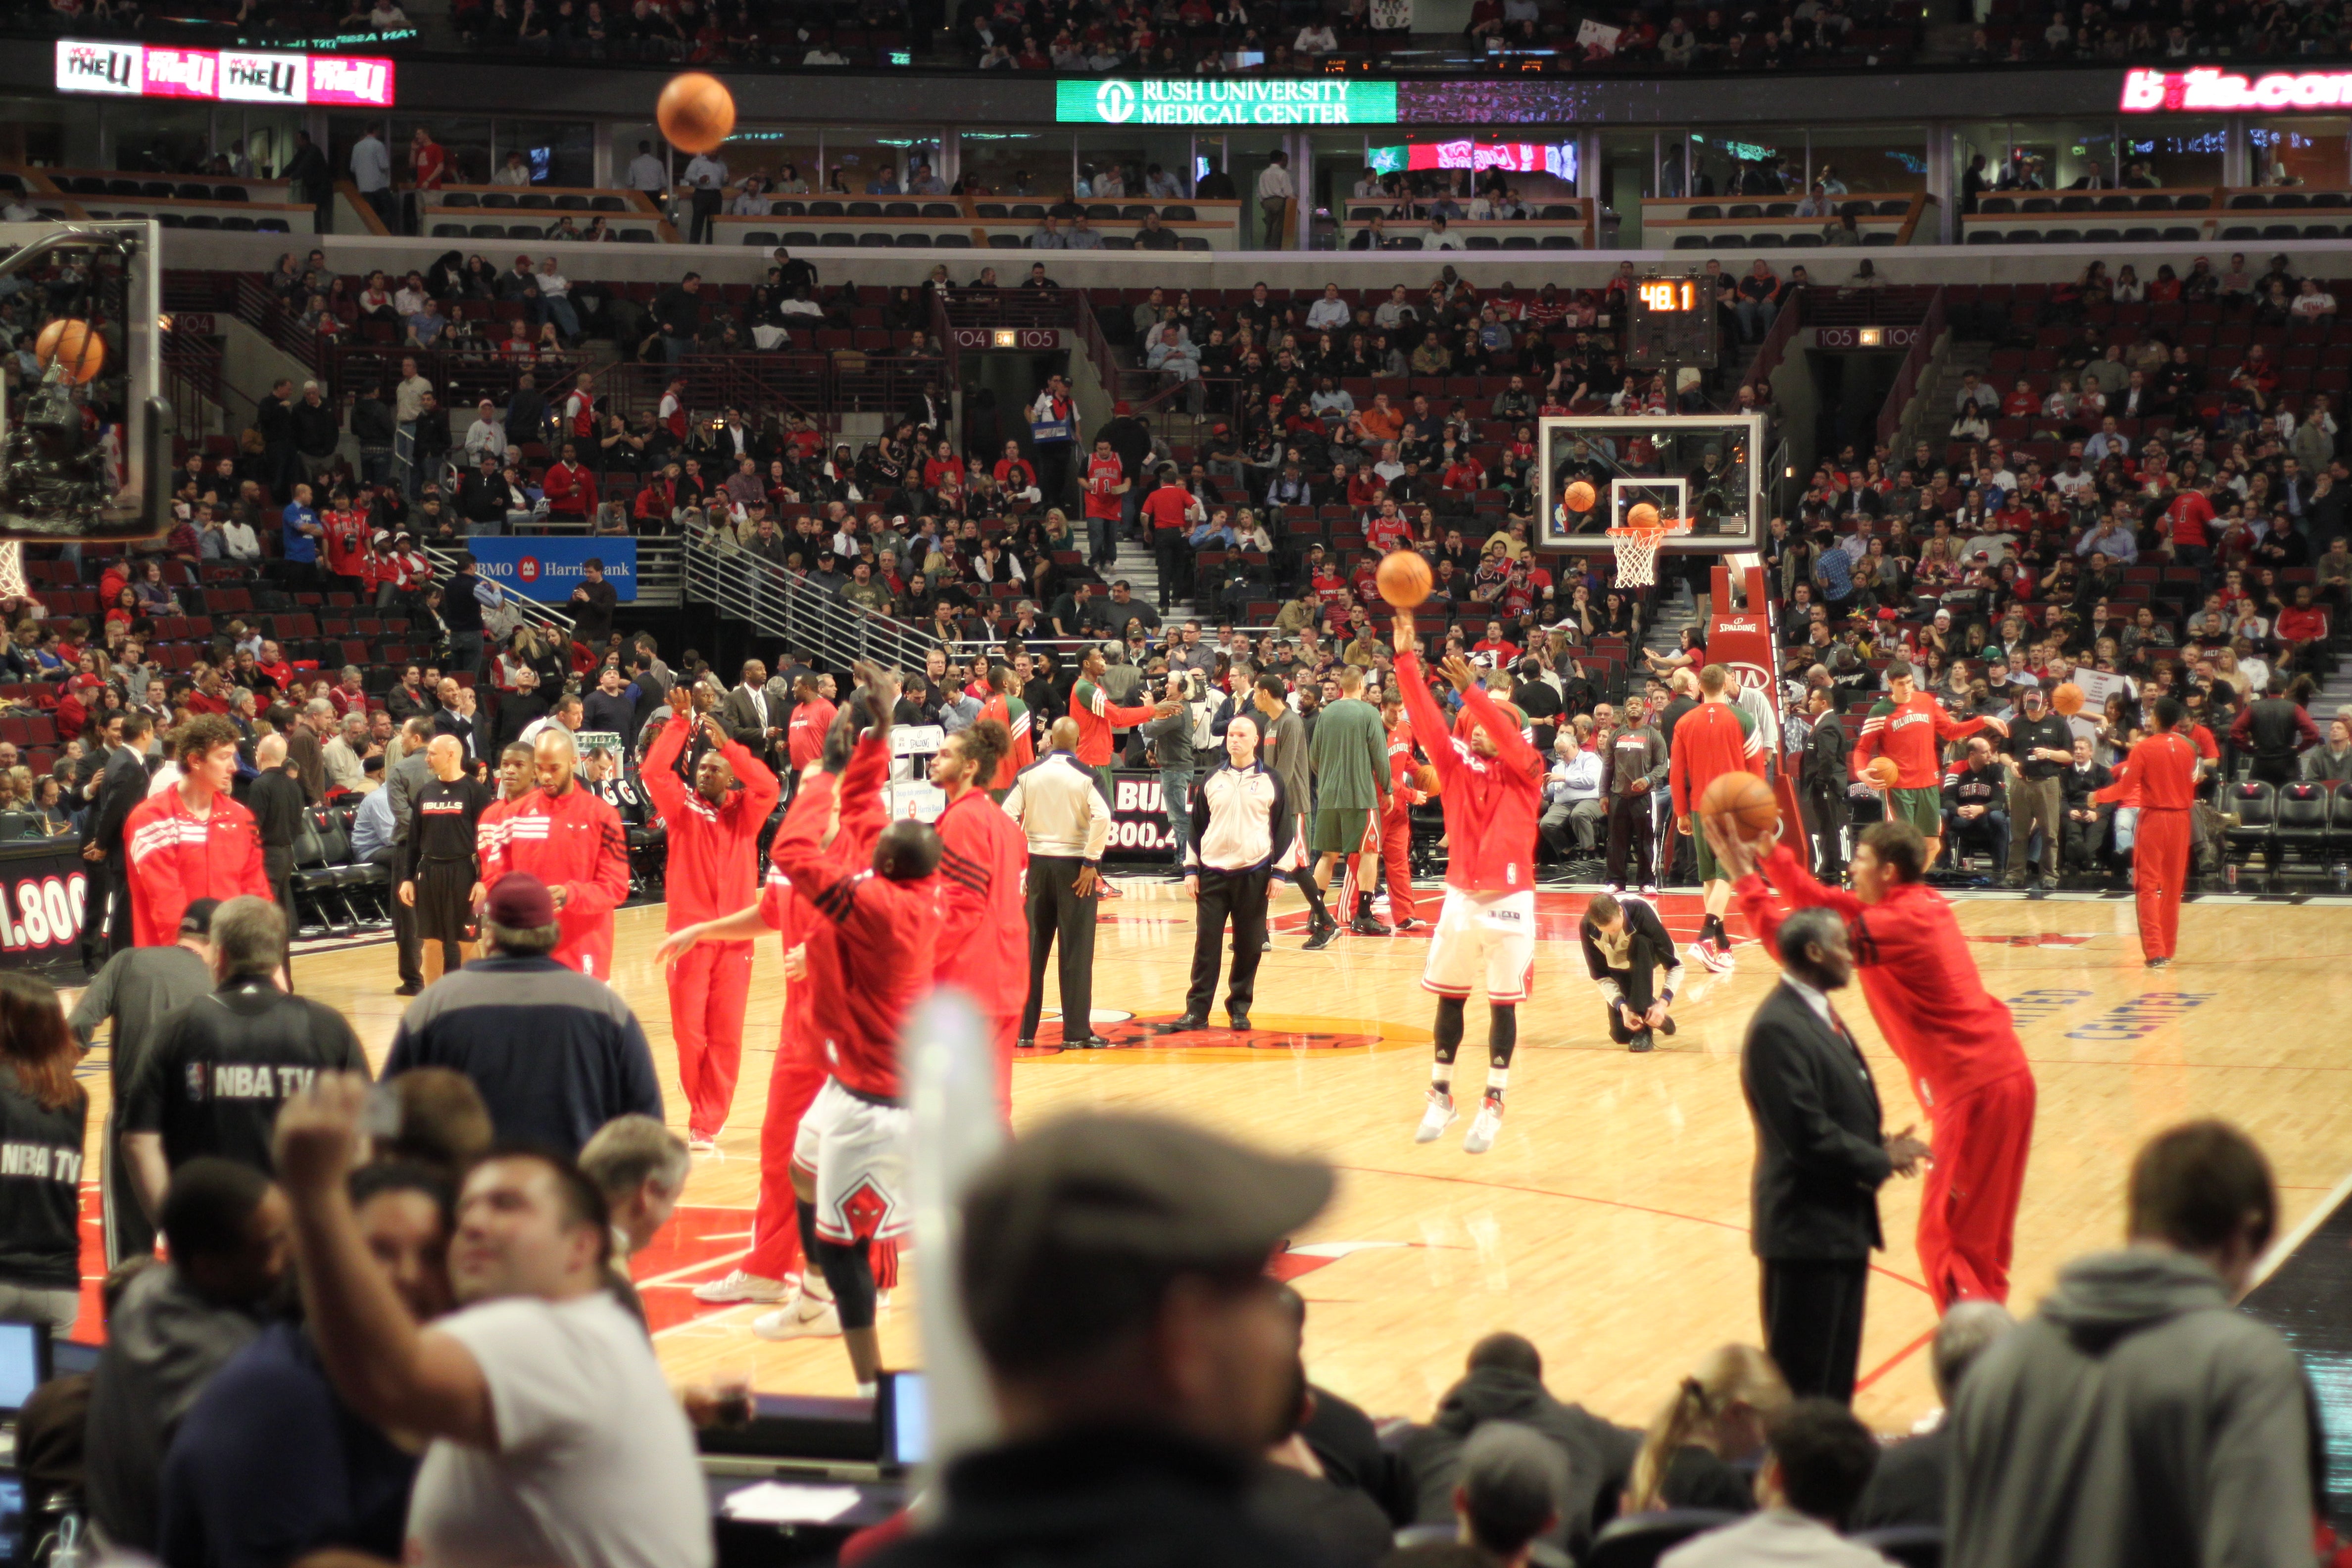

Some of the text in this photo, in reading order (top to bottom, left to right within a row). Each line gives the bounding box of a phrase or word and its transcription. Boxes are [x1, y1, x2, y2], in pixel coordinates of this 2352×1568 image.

[106, 50, 132, 88] U
[268, 60, 296, 97] U
[1142, 81, 1350, 102] RUSH UNIVERSITY
[1142, 103, 1350, 124] MEDICAL CENTER
[1640, 285, 1689, 310] 48.1
[954, 331, 985, 346] 104
[996, 333, 1013, 345] EXIT
[1023, 331, 1052, 346] 105
[1821, 330, 1852, 345] 105
[1862, 331, 1879, 344] EXIT
[1889, 329, 1919, 345] 106
[477, 563, 513, 576] BMO
[602, 562, 630, 576] ank
[1719, 623, 1756, 633] SPALDING
[1734, 670, 1759, 687] IA
[910, 738, 930, 749] SPALDING
[618, 780, 638, 805] G
[424, 801, 463, 810] BULLS
[2063, 992, 2218, 1040] CENTER
[215, 1066, 273, 1097] NBA
[1, 1143, 49, 1177] NBA
